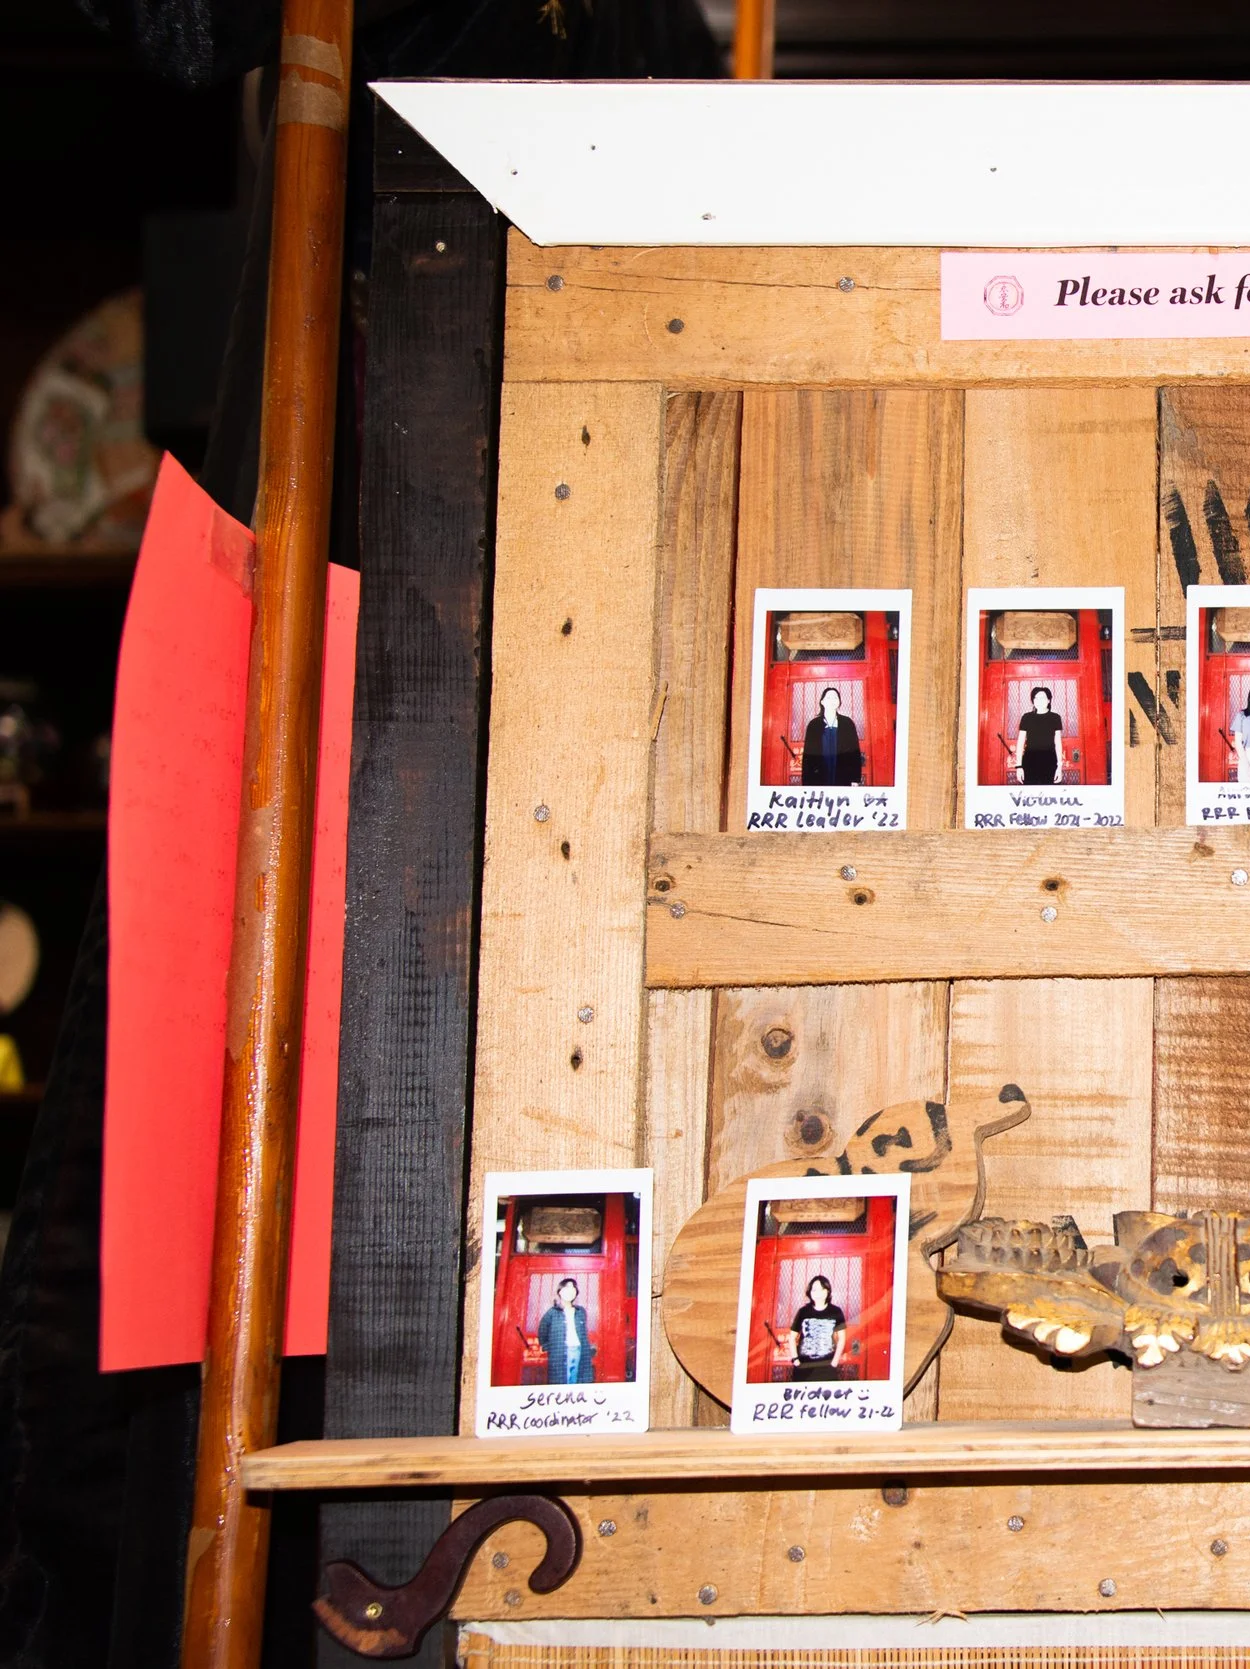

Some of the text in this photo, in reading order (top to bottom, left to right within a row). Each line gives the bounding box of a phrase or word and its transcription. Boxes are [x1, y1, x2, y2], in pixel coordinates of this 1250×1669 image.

[1054, 277, 1160, 307] Please
[1170, 275, 1223, 304] ask
[769, 791, 850, 816] Kaitlyn
[747, 812, 788, 830] RRR
[974, 813, 1005, 828] RRR
[1201, 807, 1240, 820] RRR
[487, 1412, 521, 1430] RRR
[753, 1403, 794, 1422] RRR
